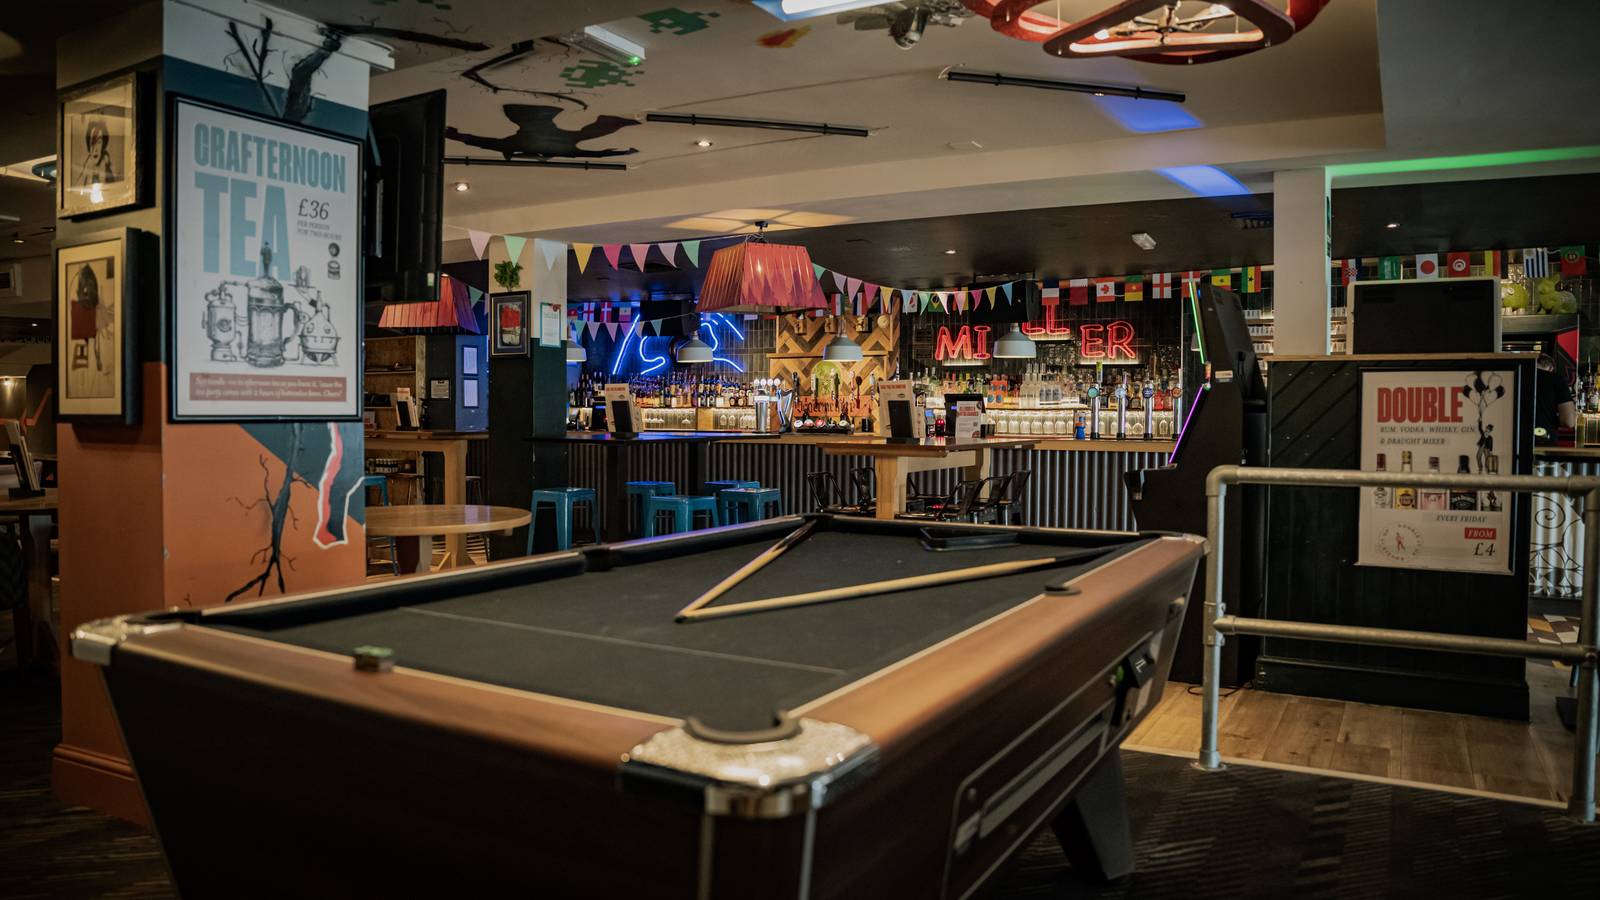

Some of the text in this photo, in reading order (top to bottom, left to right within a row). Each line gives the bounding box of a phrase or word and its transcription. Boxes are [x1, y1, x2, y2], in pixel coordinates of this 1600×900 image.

[194, 123, 346, 193] CRAFTERNOON
[298, 198, 330, 220] £36
[195, 171, 292, 281] TEA
[1377, 386, 1464, 424] DOUBLE
[1436, 514, 1487, 524] EVERY FRIDAY
[1468, 529, 1494, 538] FROM
[1473, 542, 1496, 557] £4
